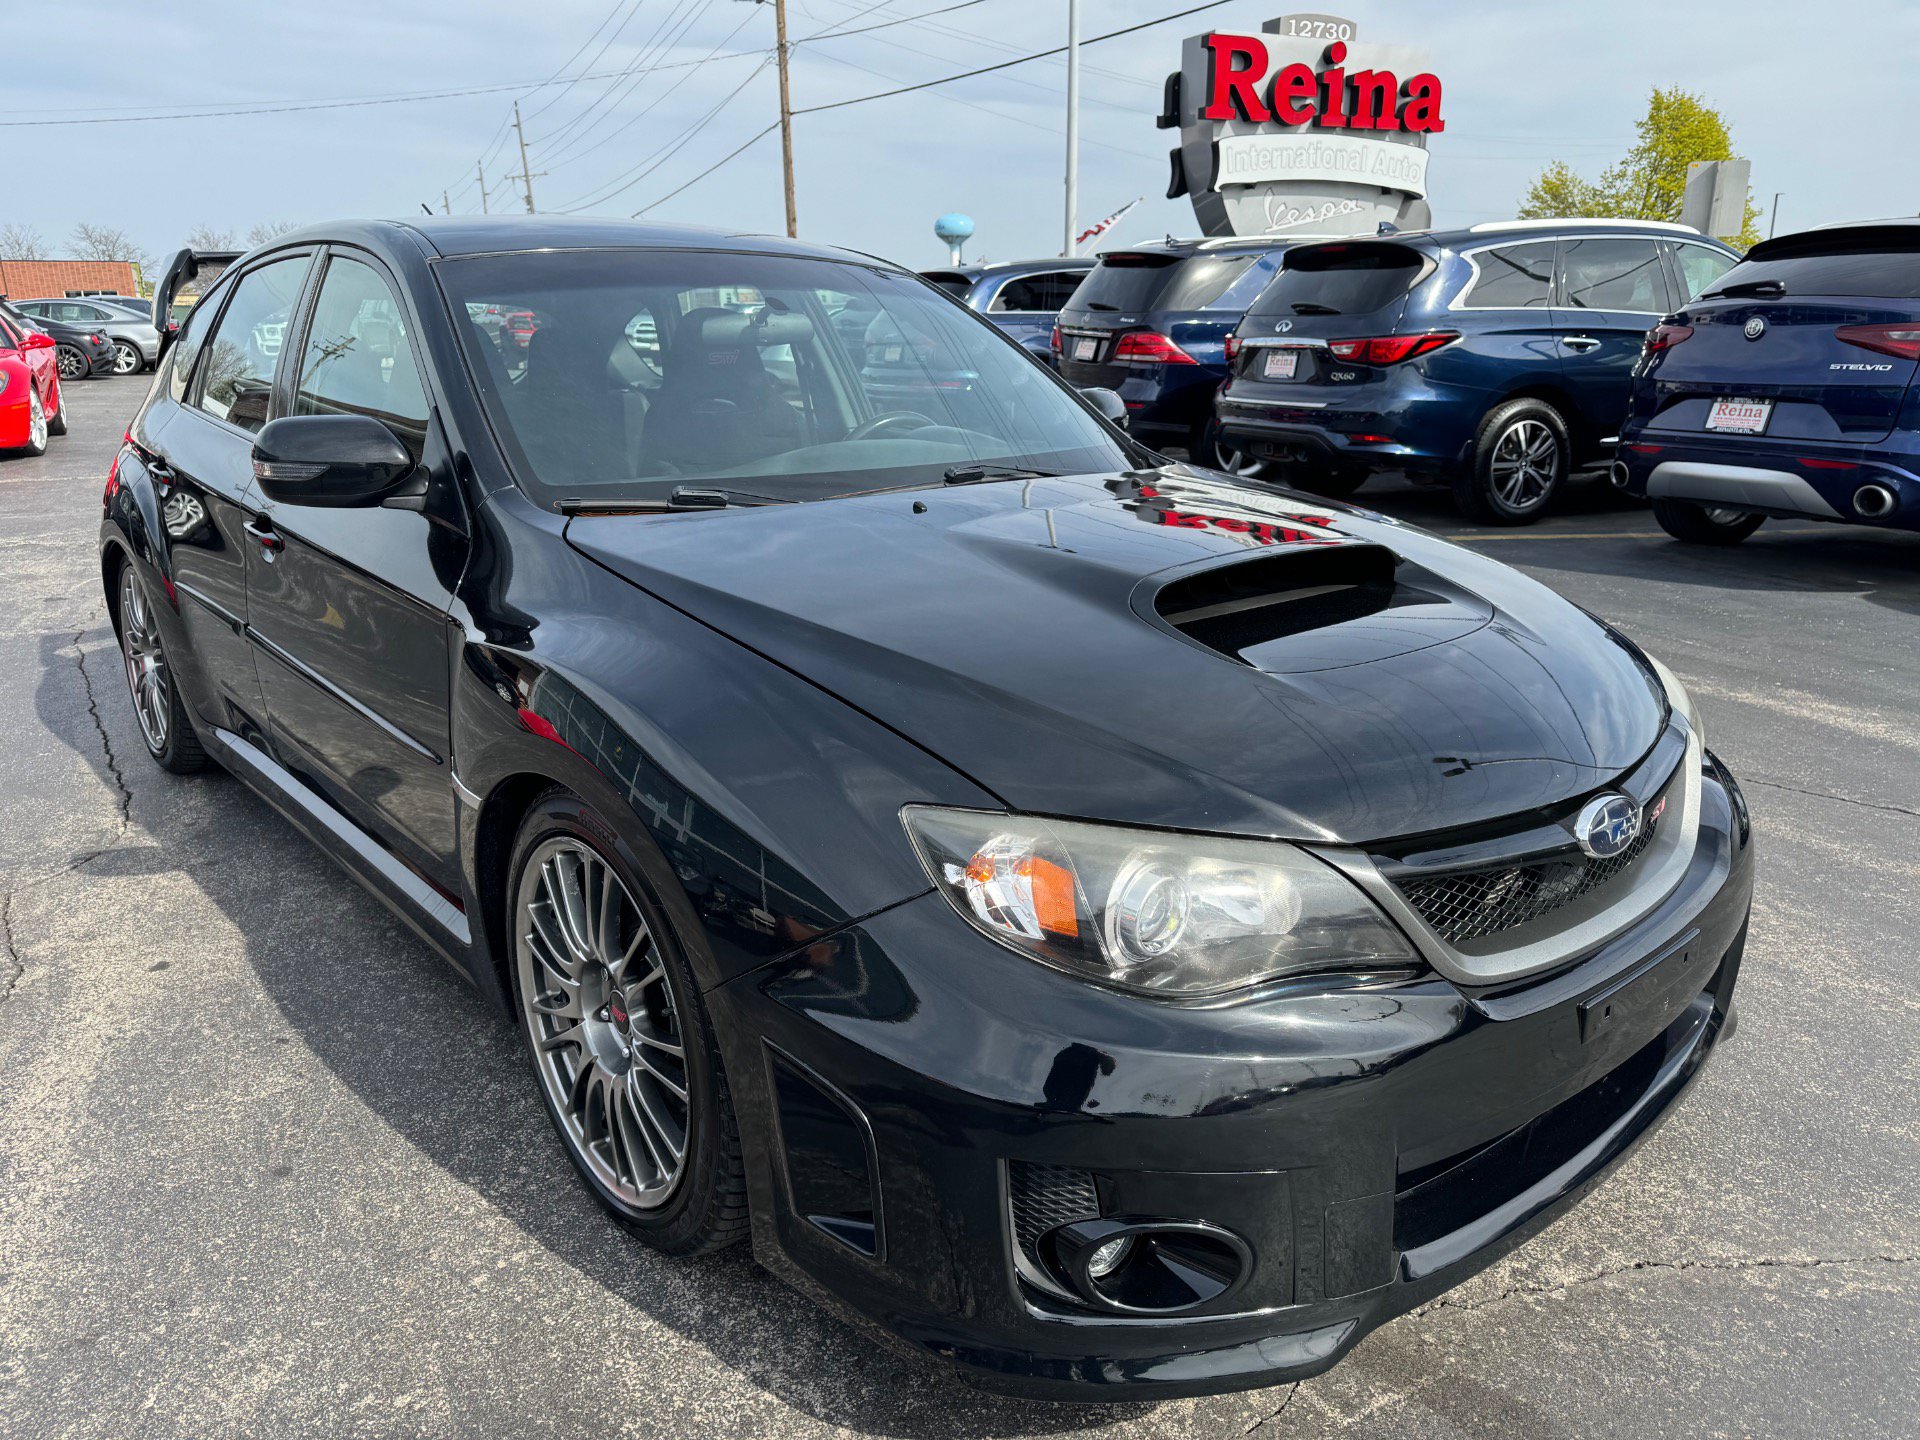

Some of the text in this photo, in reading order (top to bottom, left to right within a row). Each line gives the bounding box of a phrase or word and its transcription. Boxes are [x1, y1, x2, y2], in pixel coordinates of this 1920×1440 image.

[1288, 18, 1351, 41] 12730
[1205, 34, 1446, 133] Reina
[1226, 141, 1421, 183] International Auto
[1264, 187, 1365, 233] Vespa
[1269, 353, 1294, 367] Reina
[1829, 363, 1893, 372] STELVIO
[1330, 371, 1356, 382] QX60
[1715, 402, 1763, 419] Reina
